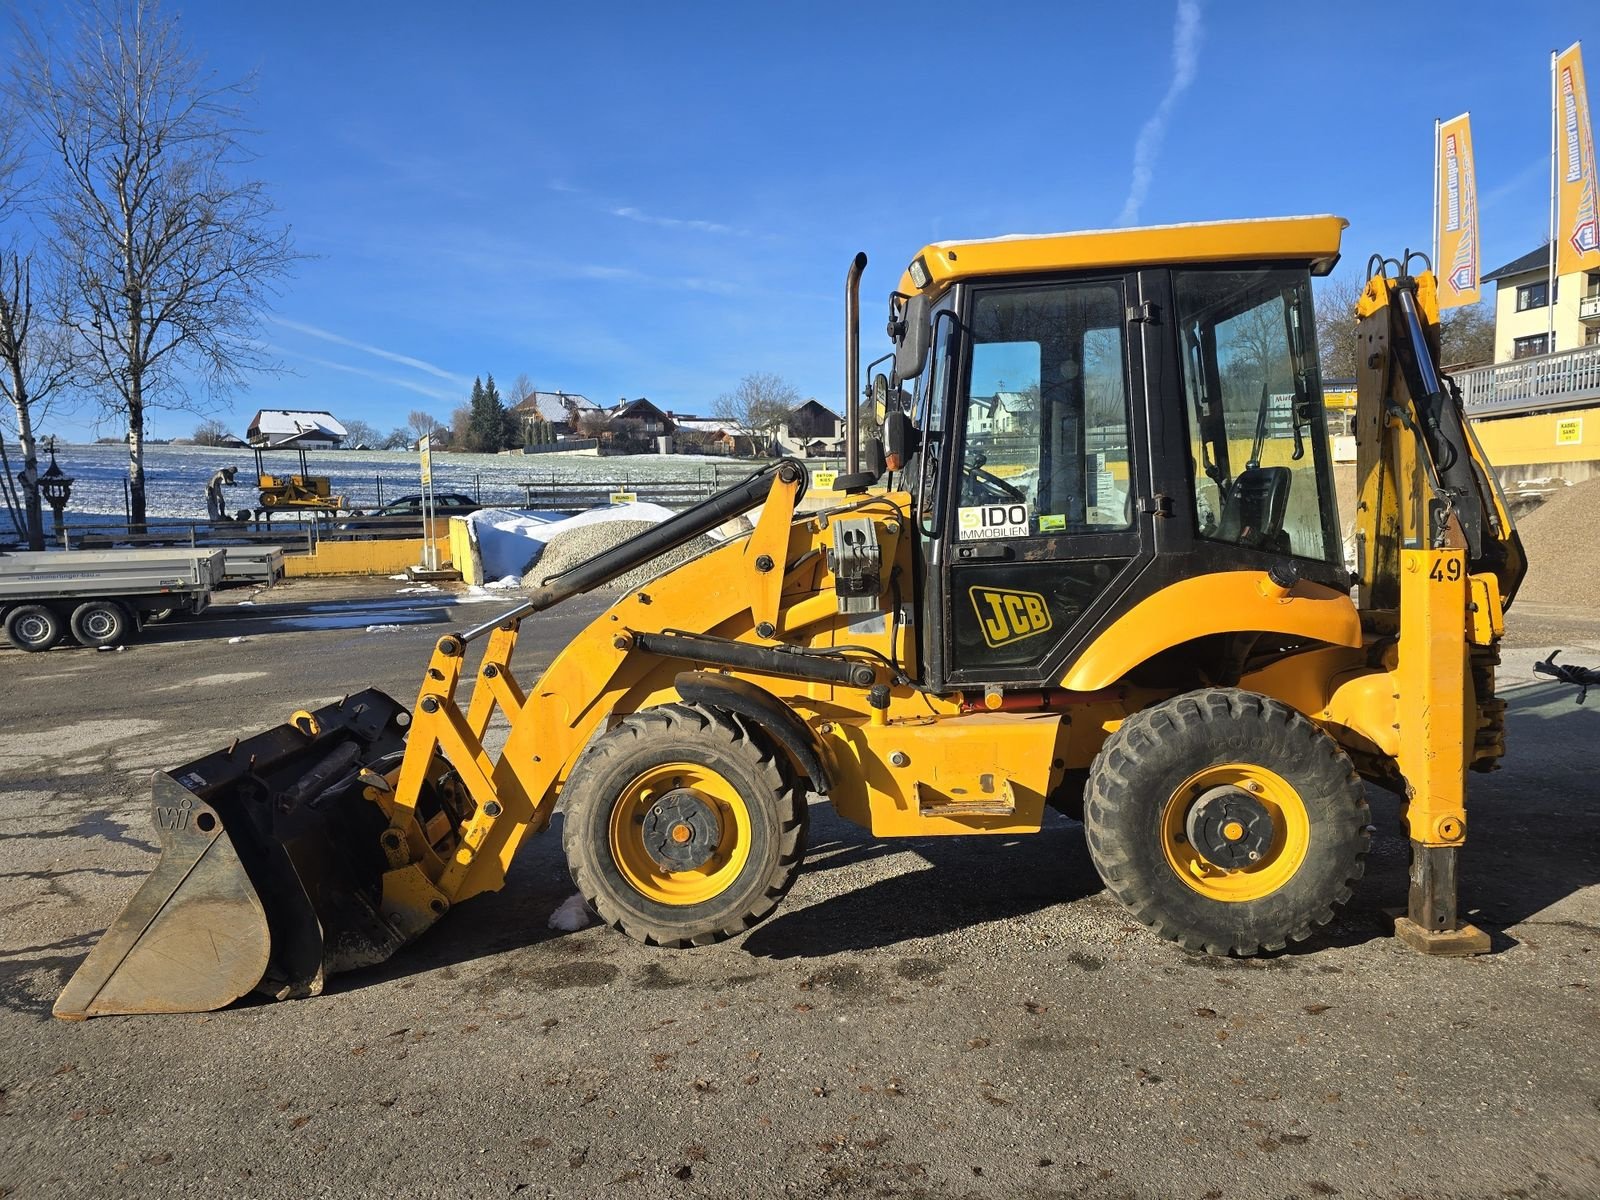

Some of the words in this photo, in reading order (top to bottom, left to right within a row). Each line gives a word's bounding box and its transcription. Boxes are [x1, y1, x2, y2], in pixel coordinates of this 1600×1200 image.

[1562, 69, 1573, 95] Bau
[1446, 135, 1456, 156] Bau
[1566, 95, 1581, 182] Hammertinger
[1446, 156, 1460, 232] Hammertinger
[959, 505, 1027, 529] SIDO
[960, 527, 1028, 539] IMMOBILIEN
[1429, 558, 1461, 582] 49
[984, 592, 1047, 641] JCB
